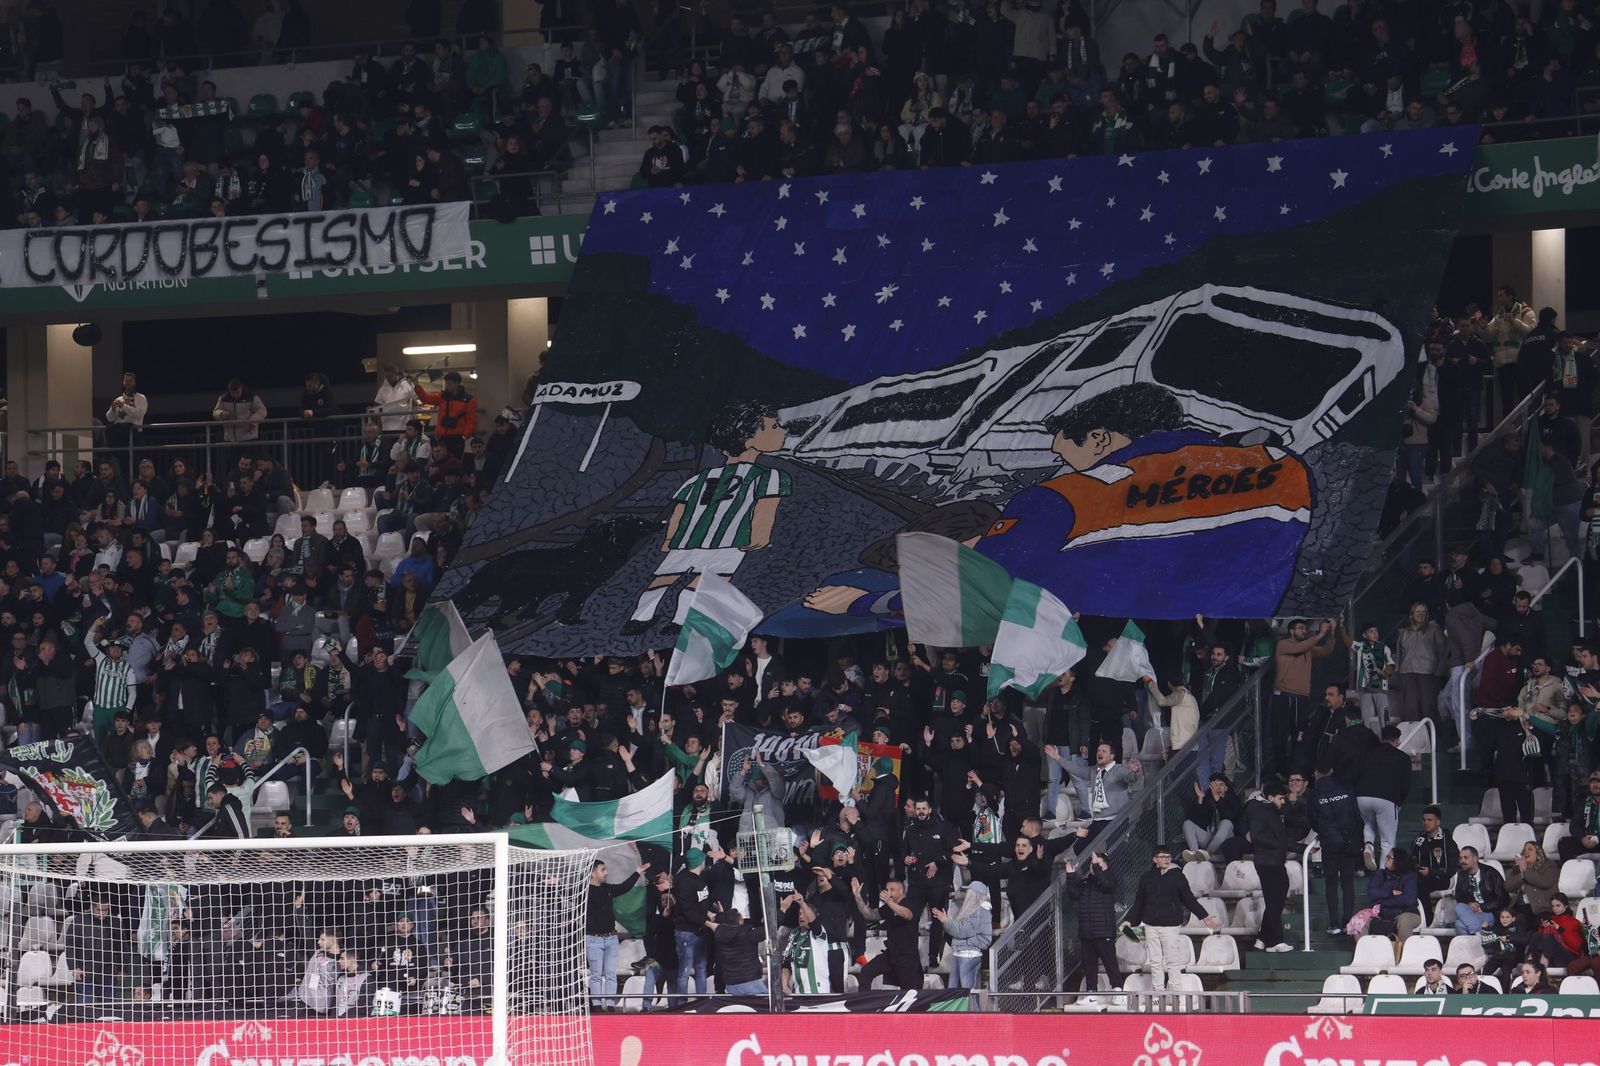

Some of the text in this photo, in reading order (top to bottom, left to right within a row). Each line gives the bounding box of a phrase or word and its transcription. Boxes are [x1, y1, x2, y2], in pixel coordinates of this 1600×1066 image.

[1474, 166, 1531, 193] Corte
[24, 205, 436, 283] CORDOBESISMO
[1127, 463, 1282, 508] HÉROES
